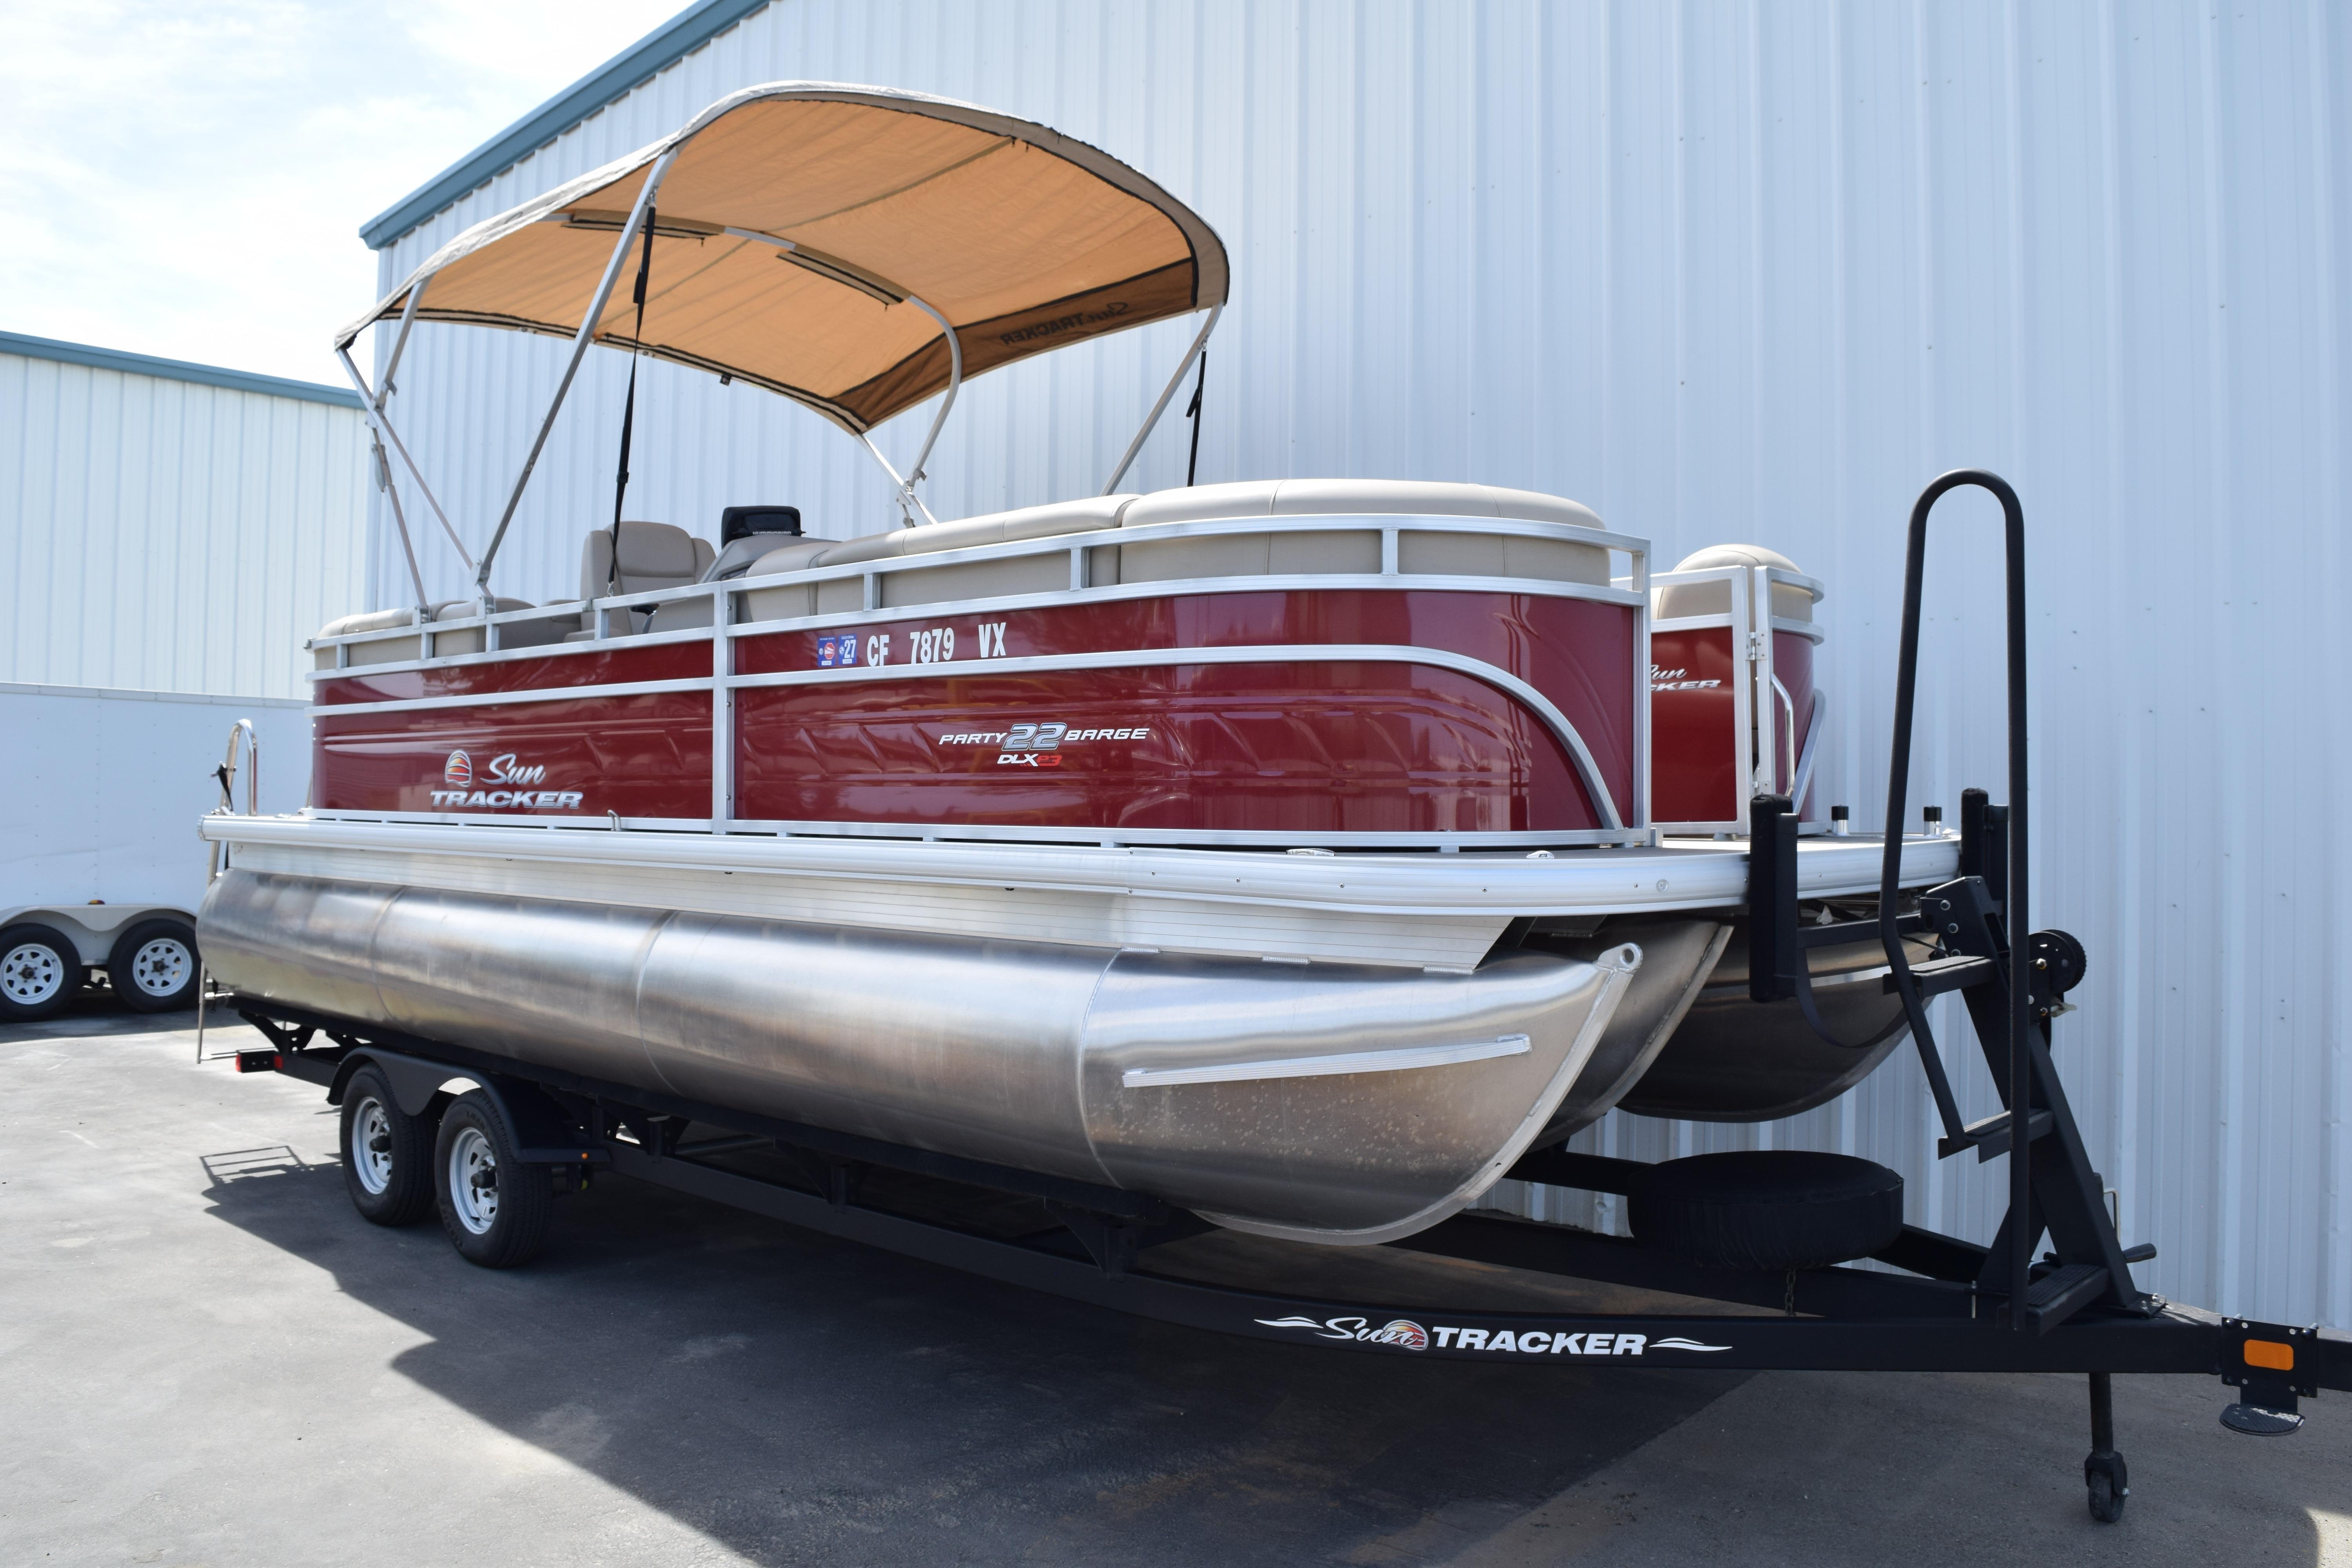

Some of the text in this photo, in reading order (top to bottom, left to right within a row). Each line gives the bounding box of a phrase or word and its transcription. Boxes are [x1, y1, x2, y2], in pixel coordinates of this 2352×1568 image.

[844, 639, 856, 659] 27
[867, 622, 1006, 666] CF 7879 VX
[939, 722, 1150, 751] PARTY 22 BARGE
[480, 753, 546, 784] Sun
[430, 791, 584, 809] TRACKER
[1313, 1317, 1647, 1356] Sun TRACKER
